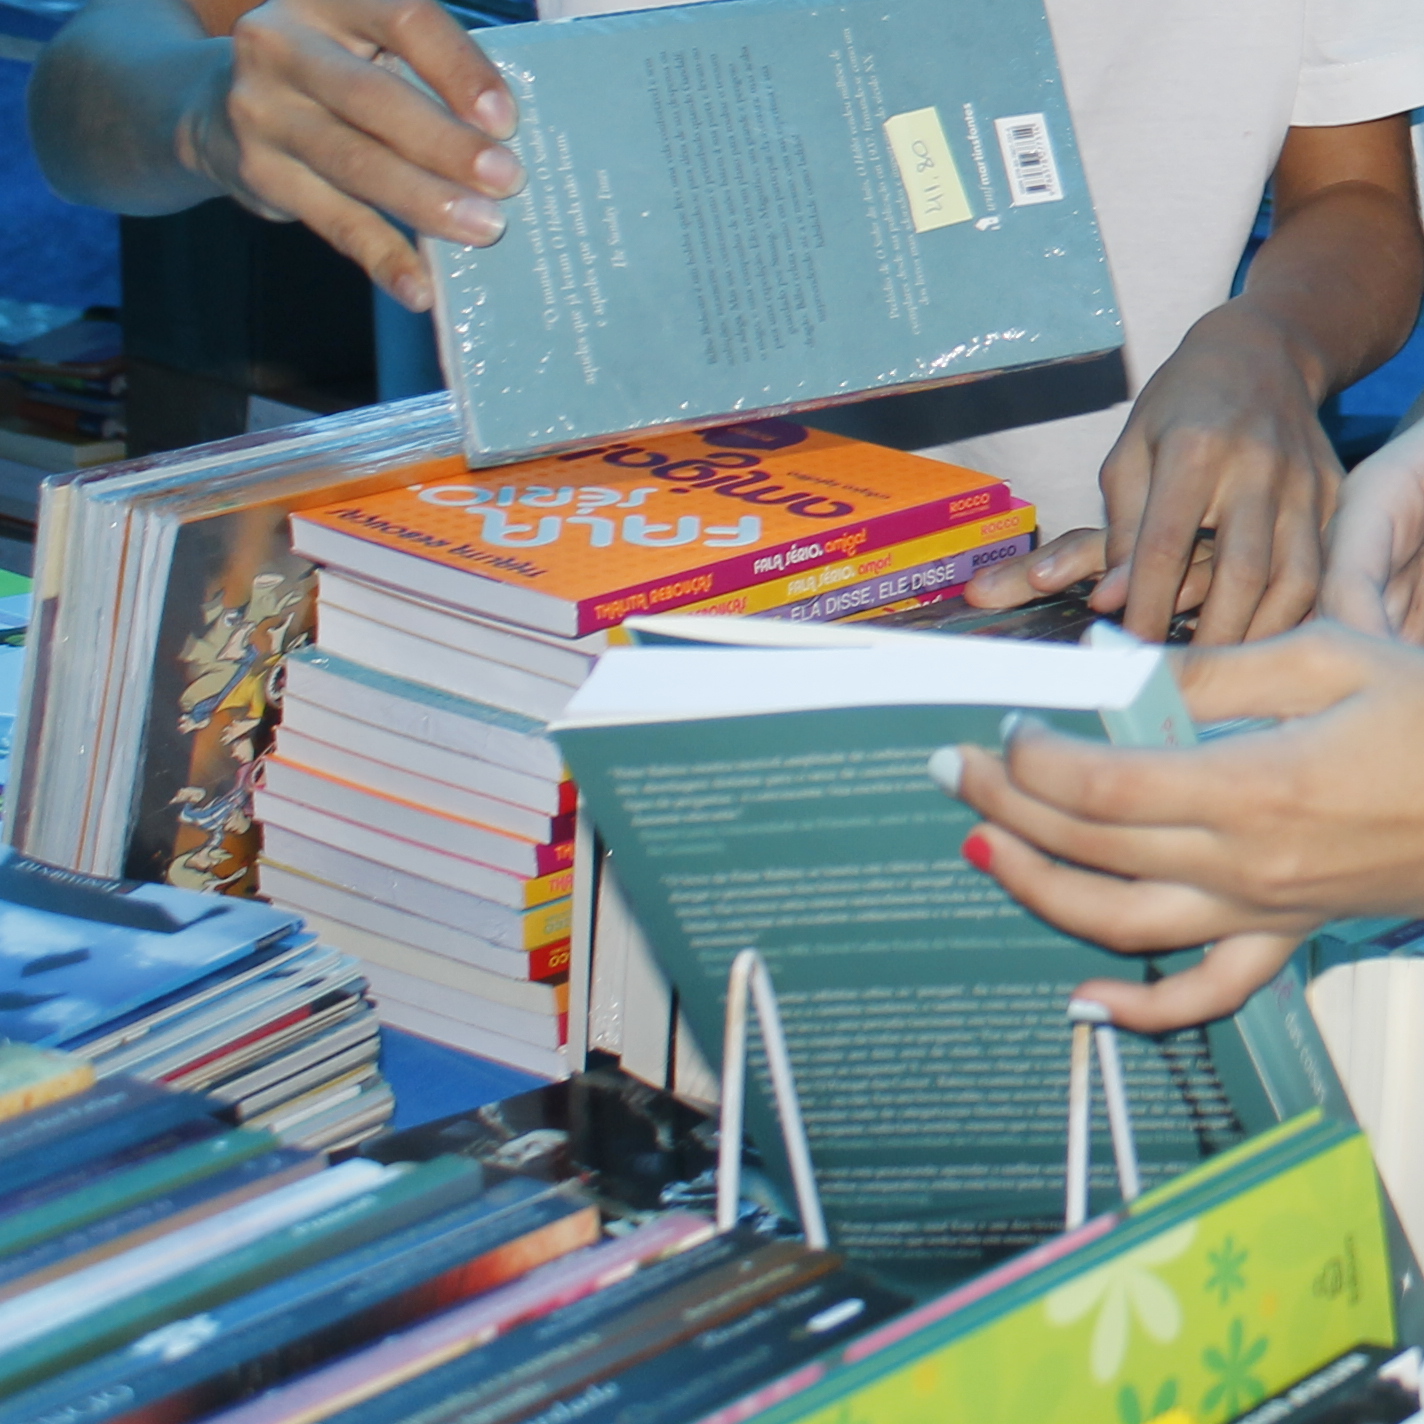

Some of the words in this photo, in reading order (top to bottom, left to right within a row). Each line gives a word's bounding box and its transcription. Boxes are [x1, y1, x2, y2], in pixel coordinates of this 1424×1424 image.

[449, 543, 548, 579] THALITA
[464, 506, 762, 548] FALA
[594, 594, 650, 621] THALITA
[649, 572, 715, 603] REBOUÇAS
[753, 552, 785, 575] FALA
[823, 528, 868, 557] amiga!
[948, 492, 991, 514] ROCCO
[787, 575, 818, 596] FALA
[857, 552, 892, 576] amor!
[980, 516, 1021, 536] ROCCO
[790, 601, 822, 624] ELA
[825, 586, 876, 616] DISSE,
[879, 578, 911, 599] ELE
[911, 563, 956, 591] DISSE
[971, 544, 1018, 567] ROCCO
